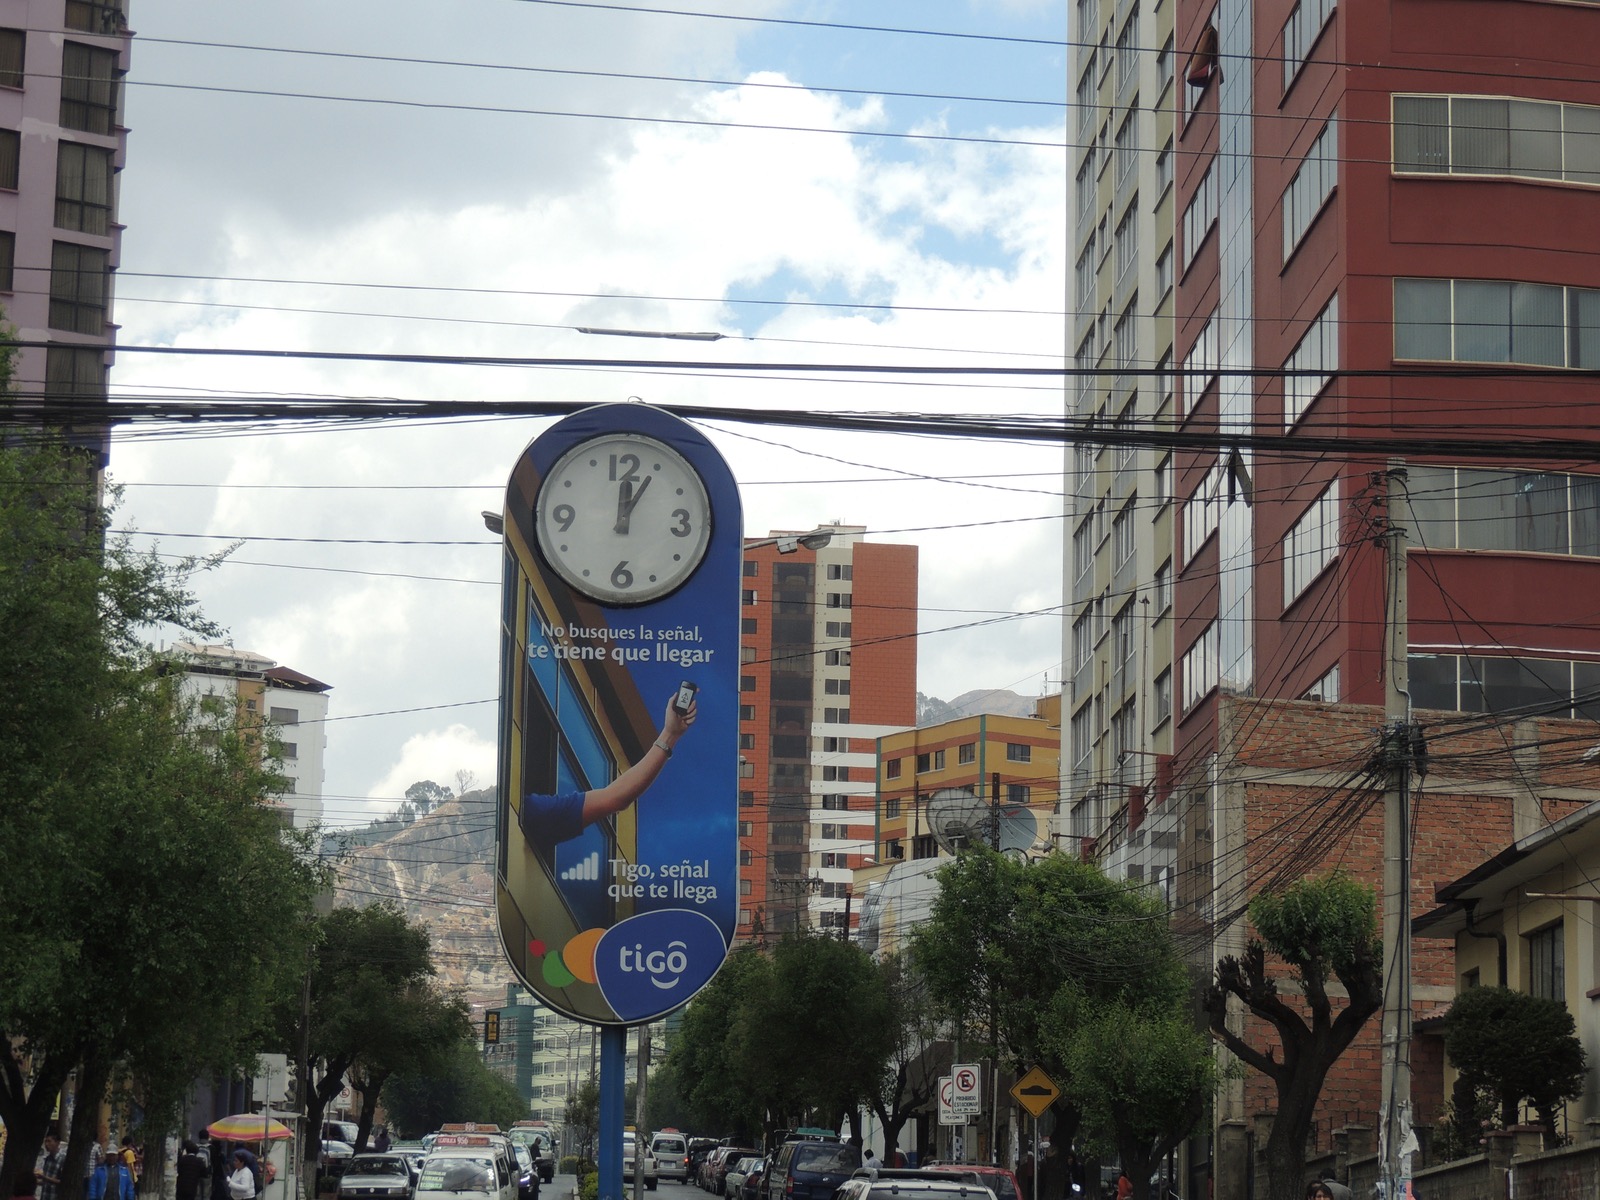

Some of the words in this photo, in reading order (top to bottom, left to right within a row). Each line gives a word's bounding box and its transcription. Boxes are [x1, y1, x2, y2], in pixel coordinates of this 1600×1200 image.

[608, 453, 641, 482] 12
[552, 503, 576, 533] 9
[670, 508, 692, 538] 3
[610, 560, 634, 589] 6
[541, 622, 565, 639] No
[569, 623, 636, 643] busques
[640, 624, 654, 640] la
[657, 625, 703, 643] señal,
[527, 642, 549, 659] te
[553, 640, 606, 660] tiene
[611, 645, 651, 666] que
[656, 643, 715, 667] llegar
[608, 859, 656, 882] Tigo,
[660, 859, 709, 879] señal
[607, 883, 645, 903] que
[649, 883, 668, 899] te
[673, 880, 718, 904] llega
